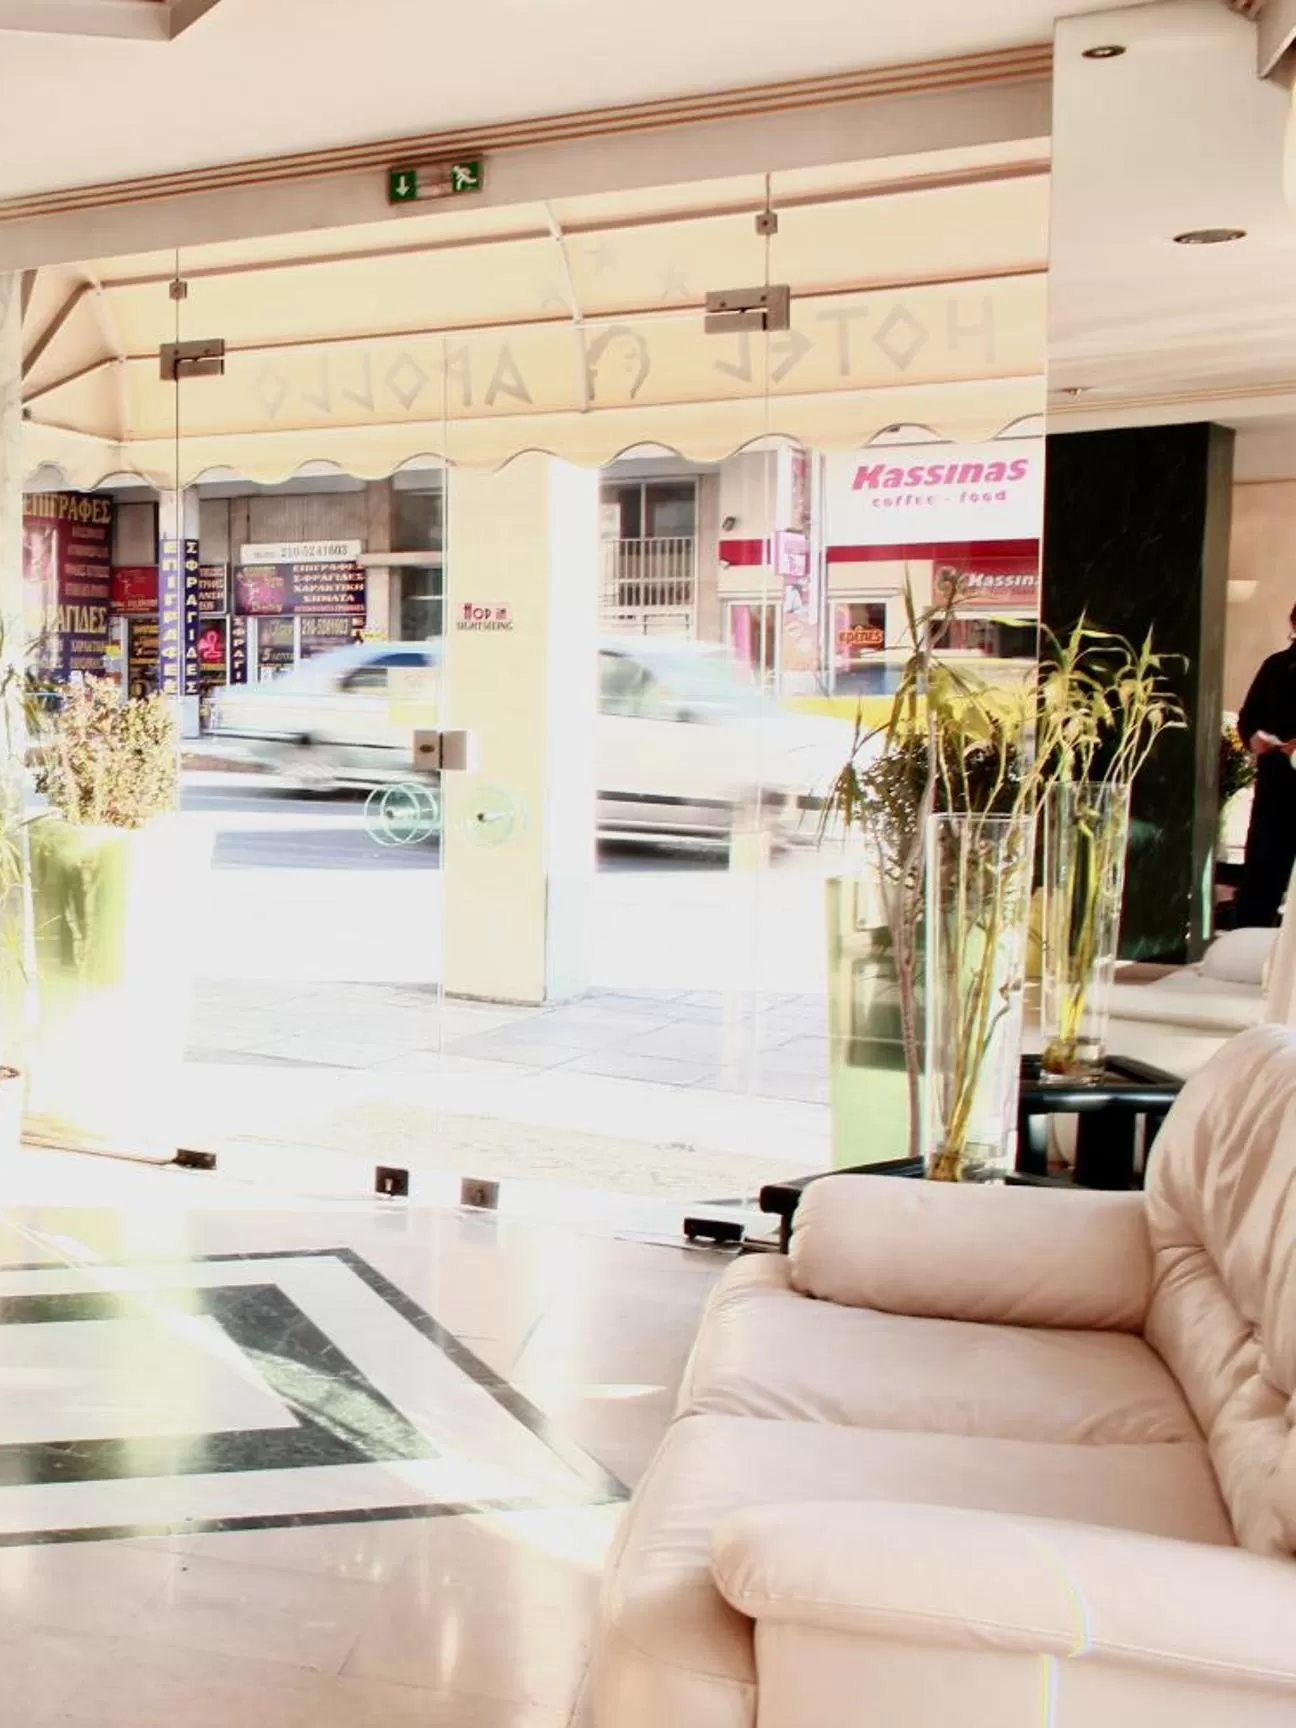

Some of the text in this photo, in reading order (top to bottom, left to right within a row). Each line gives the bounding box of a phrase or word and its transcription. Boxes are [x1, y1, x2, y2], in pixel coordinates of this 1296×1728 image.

[852, 458, 1028, 490] Kassinas
[872, 494, 935, 508] coffee
[959, 490, 1007, 504] food
[232, 616, 245, 680] ΣΦΡΑΓΙ
